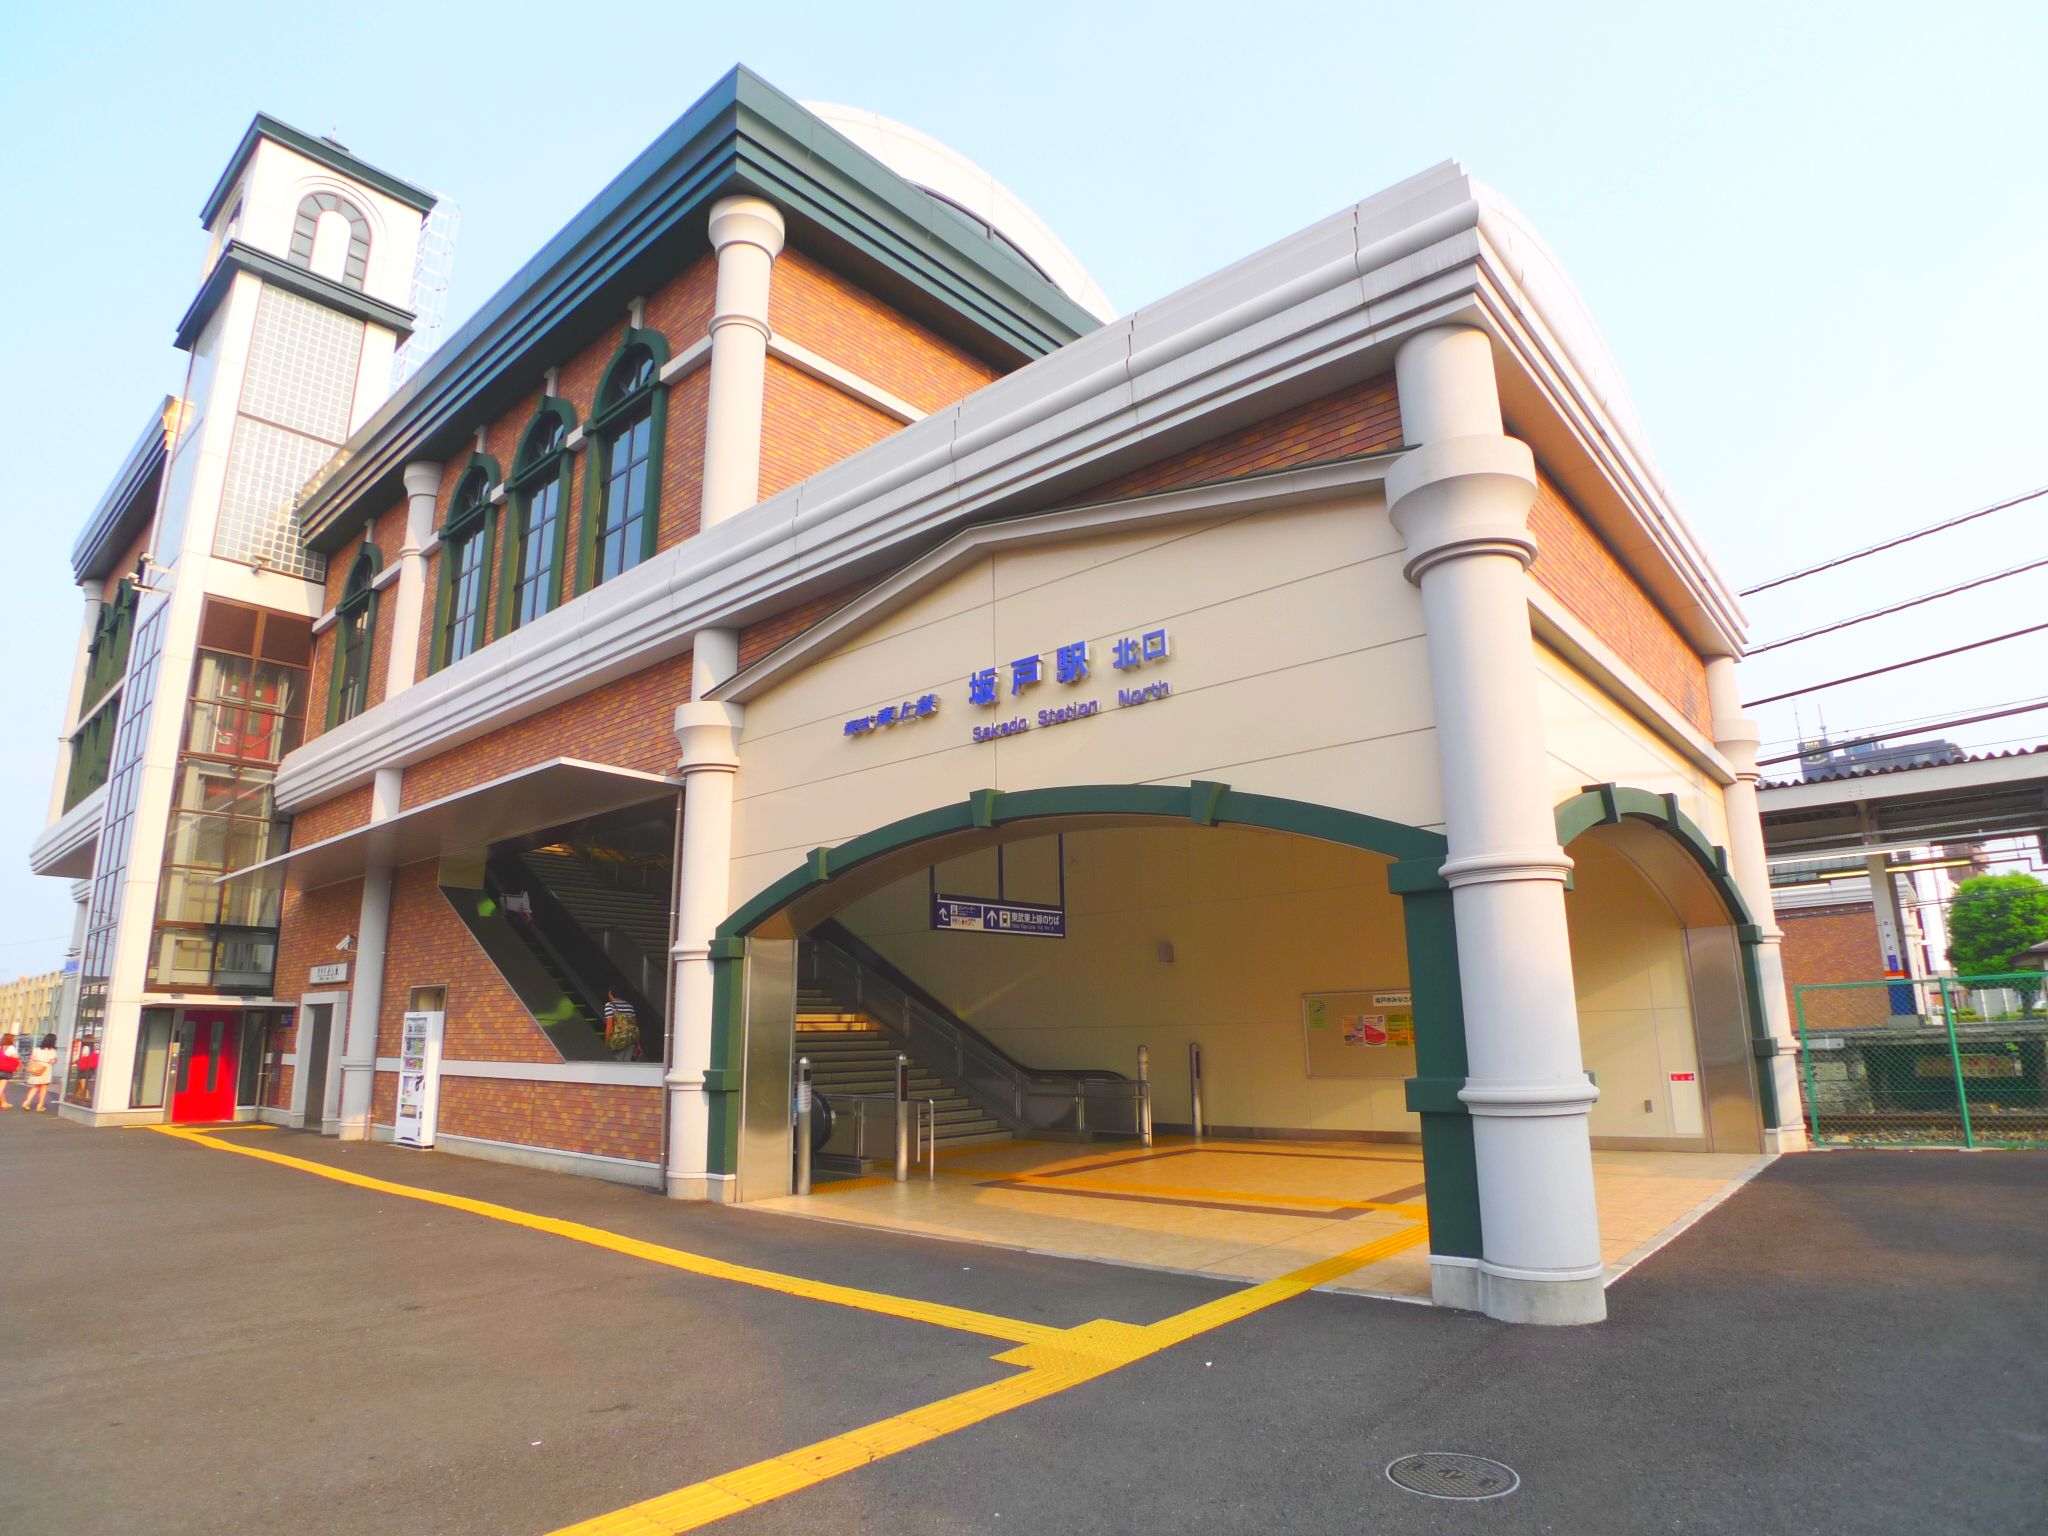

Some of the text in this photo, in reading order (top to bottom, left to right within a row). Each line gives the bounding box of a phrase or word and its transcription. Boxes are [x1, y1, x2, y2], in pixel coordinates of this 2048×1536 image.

[968, 640, 1089, 705] 坂戸駅
[1112, 628, 1169, 670] 北口
[972, 679, 1171, 743] Sakado Station North
